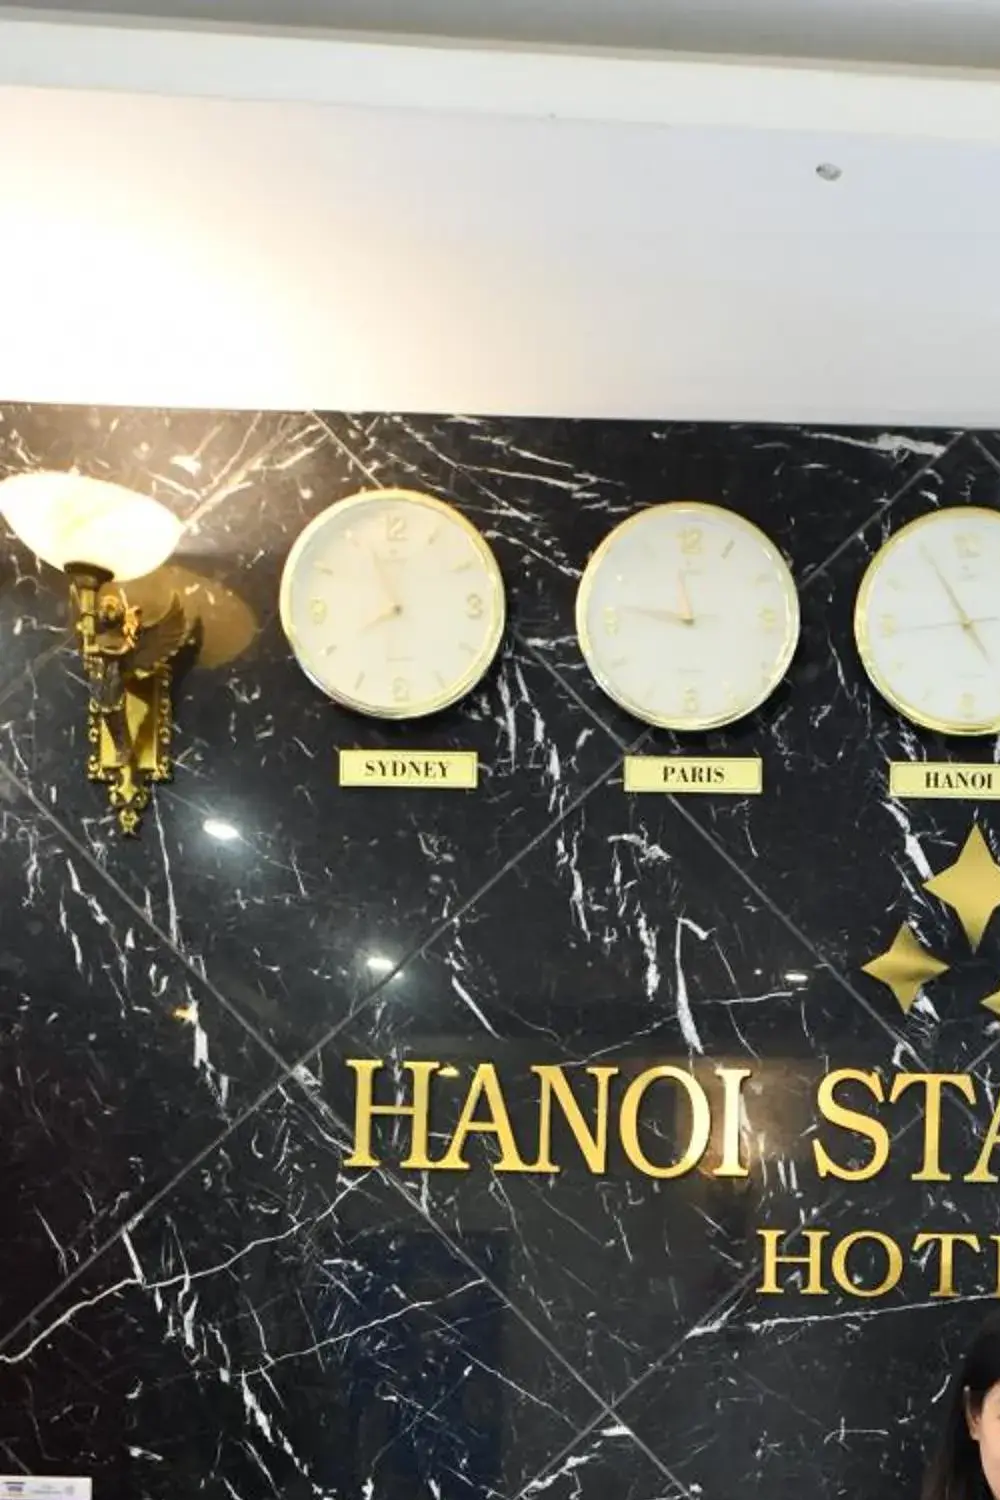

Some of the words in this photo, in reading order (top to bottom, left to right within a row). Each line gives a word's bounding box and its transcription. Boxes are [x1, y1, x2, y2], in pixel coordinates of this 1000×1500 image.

[365, 760, 450, 778] SYDNEY
[662, 766, 725, 784] PARIS
[925, 772, 992, 790] HANOI
[343, 1059, 752, 1179] HANOI
